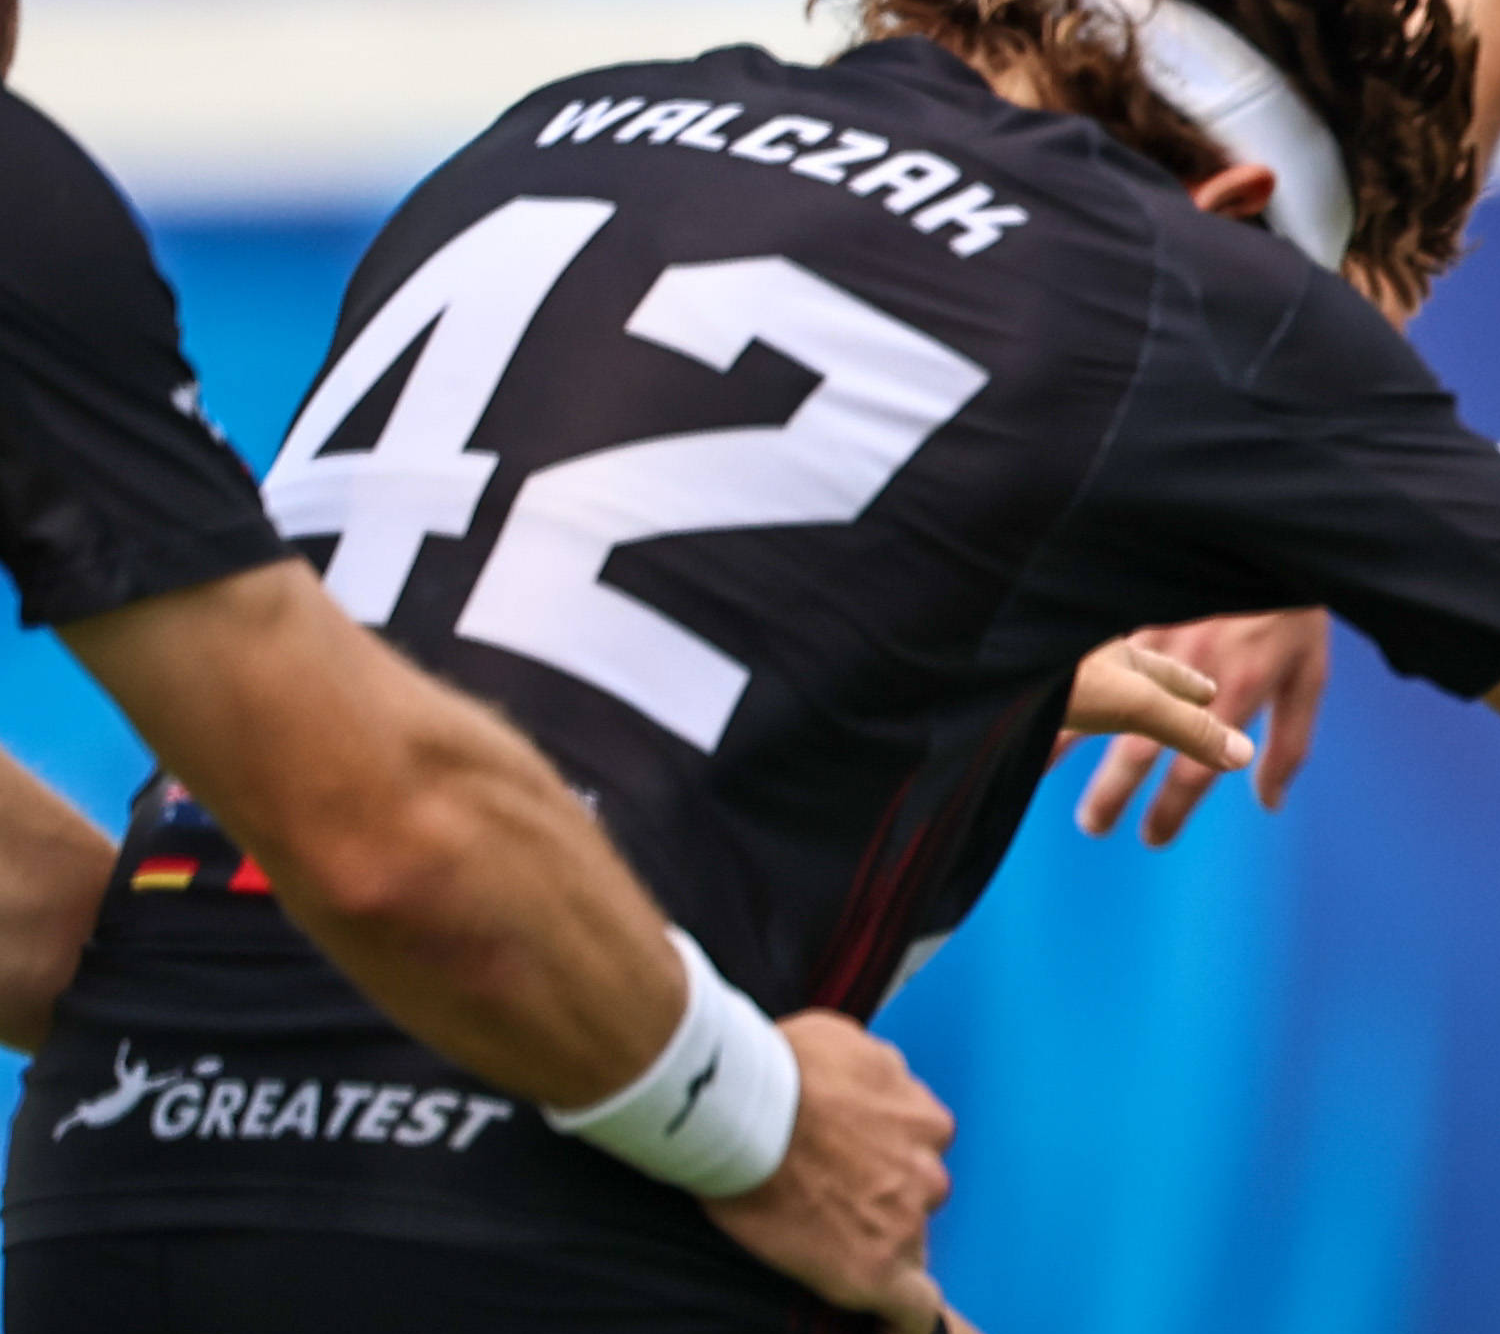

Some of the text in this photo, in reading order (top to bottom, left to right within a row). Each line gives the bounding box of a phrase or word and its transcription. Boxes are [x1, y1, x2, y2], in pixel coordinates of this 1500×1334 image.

[535, 95, 1029, 258] WALCZAK
[259, 195, 991, 754] 42
[150, 1078, 513, 1152] GREATEST
